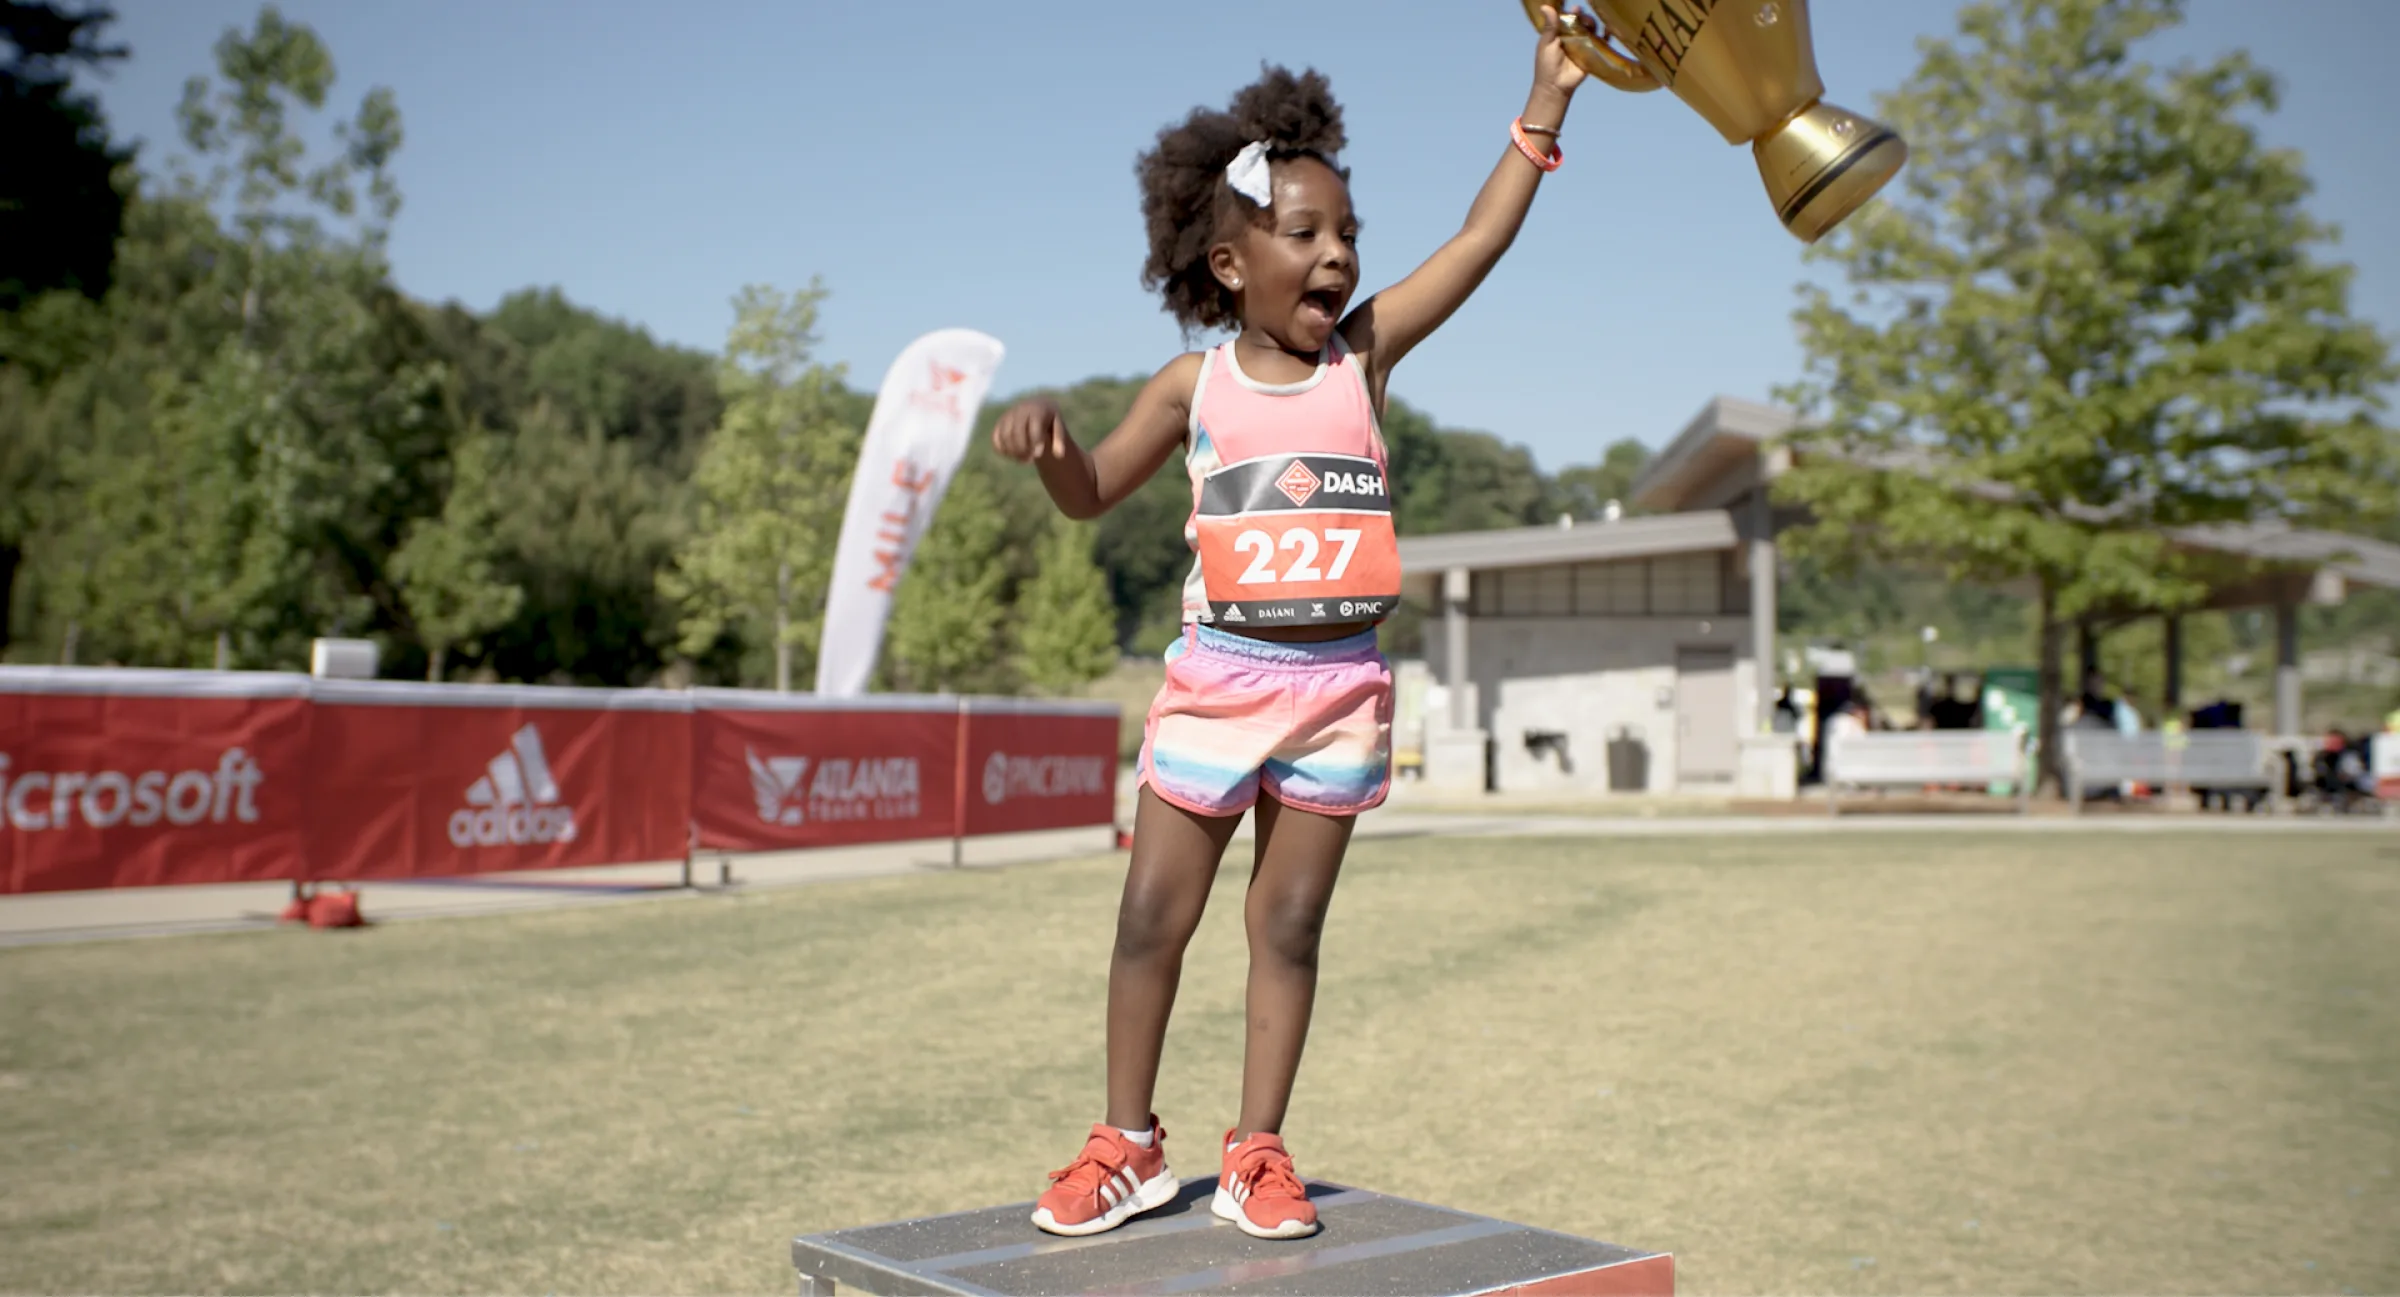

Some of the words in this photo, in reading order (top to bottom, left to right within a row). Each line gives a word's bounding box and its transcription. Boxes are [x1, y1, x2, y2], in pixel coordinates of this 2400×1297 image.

[1323, 471, 1384, 496] DASH
[866, 458, 934, 592] MILE
[1234, 527, 1362, 584] 227
[1258, 607, 1295, 619] DASANI
[1354, 602, 1382, 614] PNC
[809, 757, 920, 800] ATLANTA
[448, 801, 577, 847] adidas
